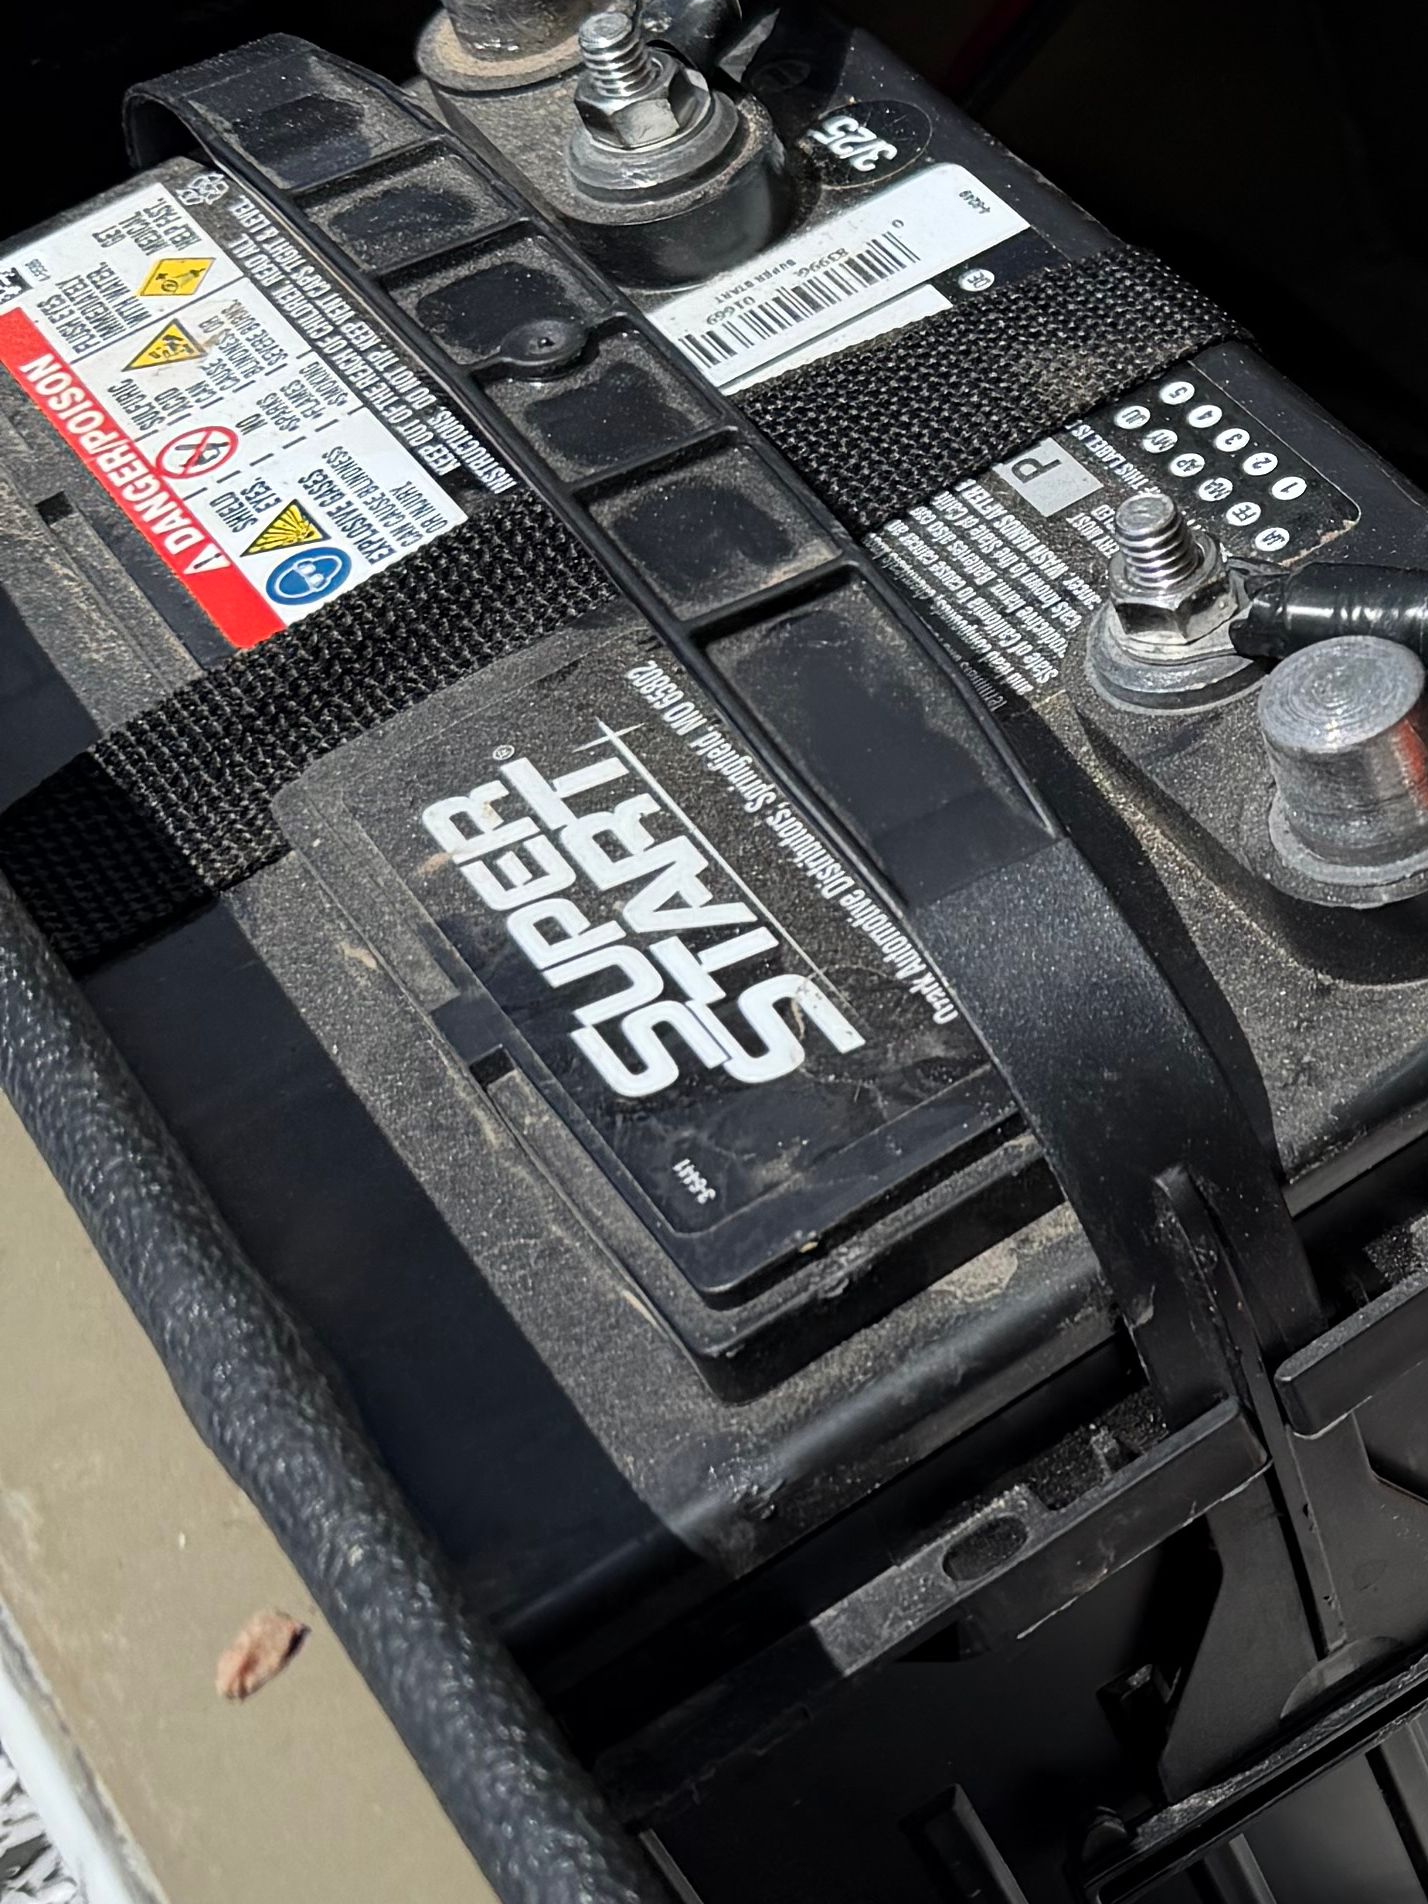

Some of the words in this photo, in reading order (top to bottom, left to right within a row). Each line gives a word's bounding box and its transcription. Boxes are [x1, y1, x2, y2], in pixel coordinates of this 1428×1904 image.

[804, 109, 902, 174] 3/25
[141, 197, 181, 228] FAST.
[224, 193, 271, 234] LEVEL.
[91, 222, 127, 249] GET
[117, 210, 171, 257] MEDICAL
[159, 217, 202, 251] HELP
[225, 232, 261, 260] ALL
[253, 225, 279, 242] &
[241, 251, 286, 288] READ
[262, 233, 307, 272] TIGHT
[751, 255, 797, 286] SUPER
[83, 261, 131, 301] WATER.
[290, 264, 332, 298] CAPS
[711, 278, 755, 306] START
[34, 292, 75, 323] EYES
[54, 271, 128, 341] IMMEDIATELY
[110, 293, 153, 327] WITH
[196, 314, 224, 334] OR
[217, 298, 258, 332] BURNS.
[269, 280, 335, 340] CHILDREN.
[314, 289, 357, 325] VENT
[703, 293, 756, 327] 01669
[55, 315, 101, 355] FLUSH
[240, 324, 289, 367] SEVERE
[314, 329, 349, 355] OF
[337, 315, 382, 351] KEEP
[208, 327, 265, 379] BLINDNESS
[330, 346, 381, 389] REACH
[364, 343, 400, 370] TIP.
[183, 378, 217, 405] CAN
[198, 355, 242, 392] CAUSE
[380, 359, 422, 393] NOT
[106, 376, 167, 432] SULFURIC
[154, 384, 194, 417] ACID
[360, 378, 400, 409] THE
[378, 398, 414, 425] OF
[404, 384, 440, 410] DO
[233, 411, 269, 436] NO
[396, 416, 436, 448] OUT
[1068, 422, 1095, 441] IS
[16, 349, 207, 555] DANGER/POISON
[417, 438, 463, 476] KEEP
[424, 404, 518, 494] INSTRUCTIONS.
[1079, 432, 1128, 470] LABEL
[295, 466, 347, 509] GASES
[319, 443, 381, 499] BLINDNESS
[1112, 460, 1151, 490] THIS
[207, 490, 260, 534] SHIELD
[236, 477, 283, 514] EYES.
[361, 491, 407, 529] CAUSE
[388, 478, 436, 520] INJURY
[960, 483, 1009, 522] AFTER
[324, 500, 398, 566] EXPLOSIVE
[388, 520, 425, 549] CAN
[416, 511, 450, 535] OR
[883, 516, 911, 537] an
[922, 519, 958, 547] also
[953, 512, 980, 531] of
[965, 522, 1005, 554] State
[991, 512, 1041, 552] HANDS
[1064, 508, 1104, 541] MUST
[897, 528, 941, 565] cancer
[942, 538, 998, 585] Batteries
[988, 545, 1021, 569] the
[1023, 542, 1072, 580] WASH
[927, 558, 969, 591] cause
[1005, 560, 1032, 579] to
[950, 583, 979, 604] to
[982, 576, 1028, 613] harm.
[1014, 570, 1063, 609] known
[921, 593, 996, 657] compounds,
[961, 594, 1025, 647] California
[1009, 604, 1076, 660] roductive
[977, 648, 1016, 679] lead
[1002, 635, 1034, 659] of
[621, 656, 687, 713] 65802
[1000, 670, 1035, 697] and
[1016, 649, 1061, 685] State
[659, 696, 710, 737] MO
[682, 720, 784, 816] Springfield,
[753, 798, 859, 900] Distributors,
[409, 776, 732, 1104] SUPER
[495, 754, 869, 1092] START
[829, 885, 931, 983] Automotive
